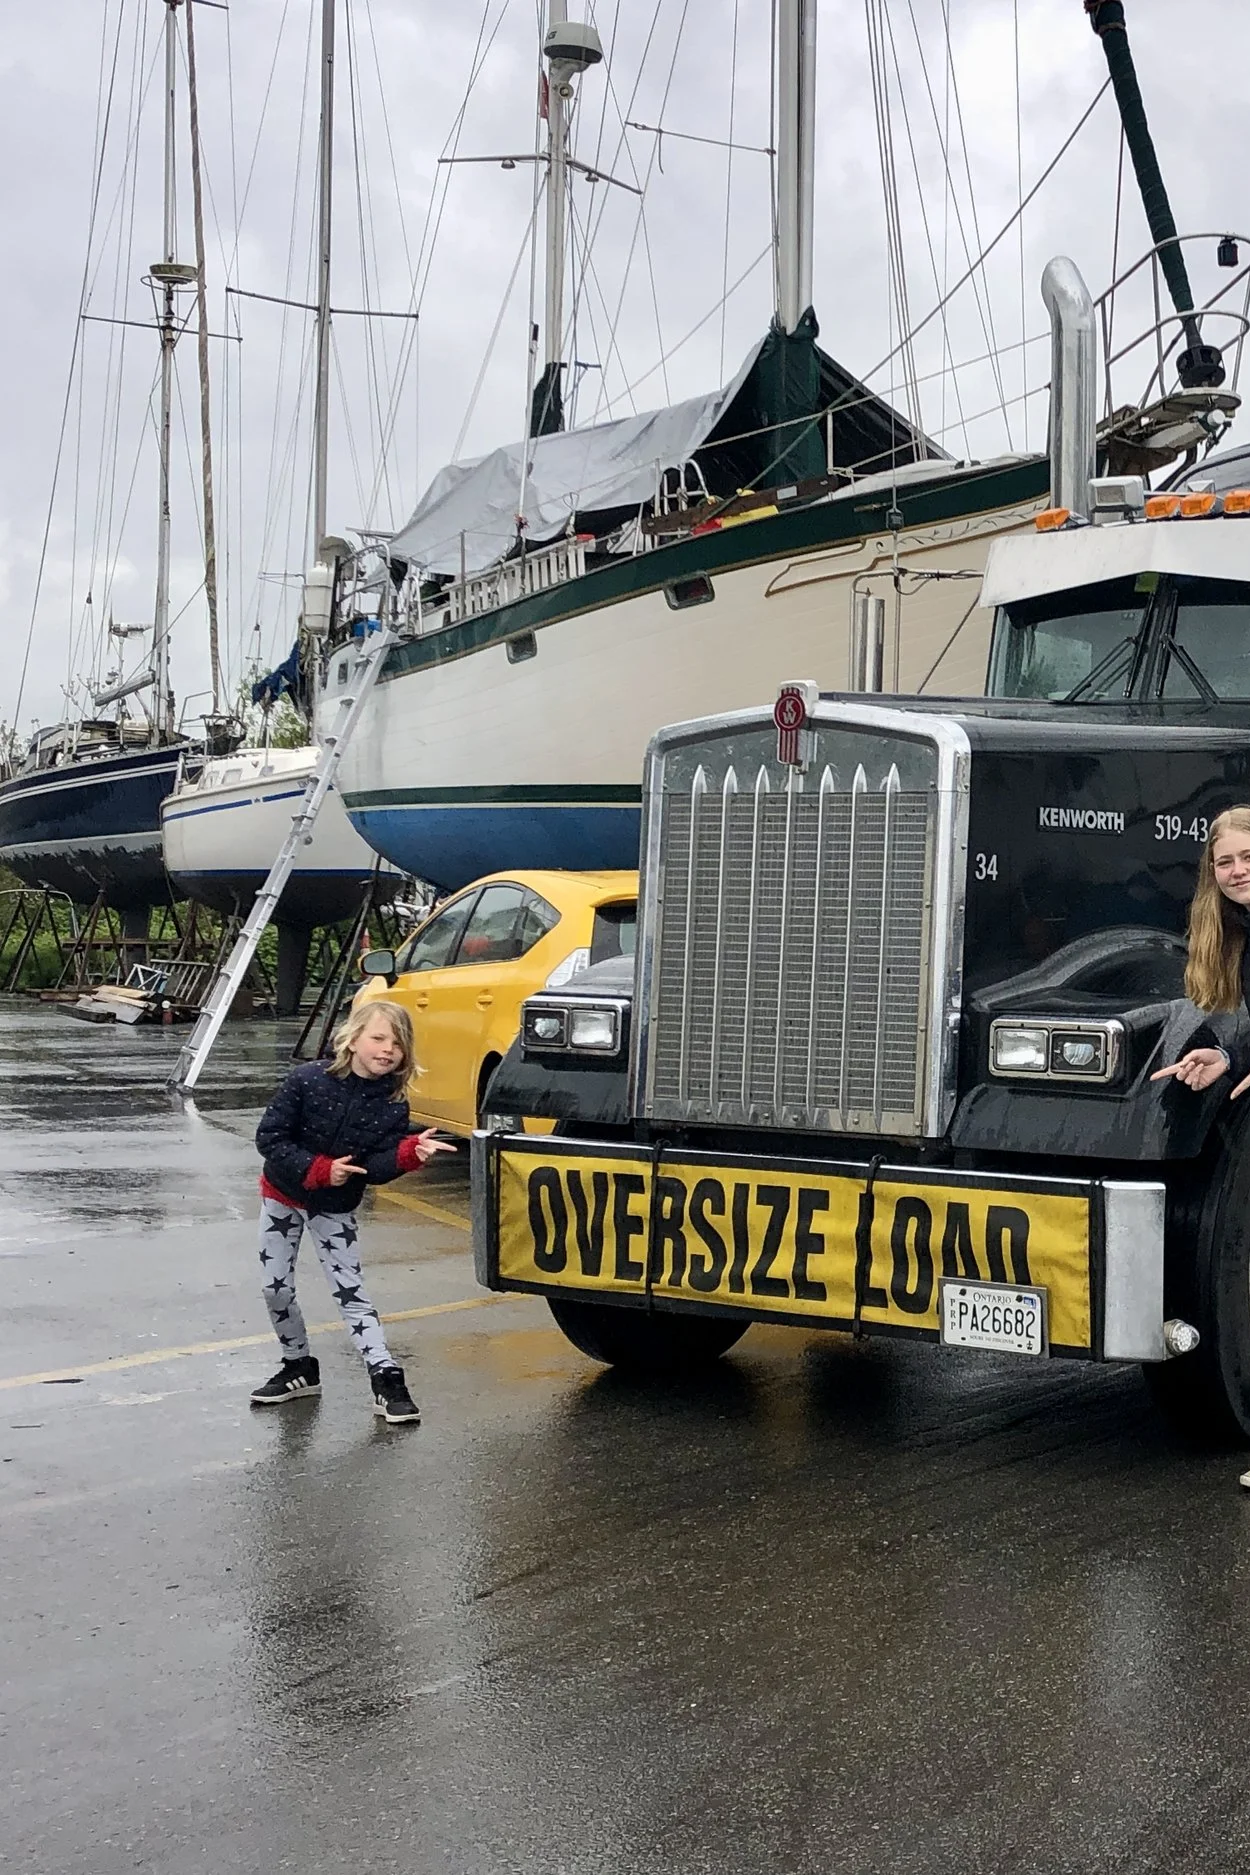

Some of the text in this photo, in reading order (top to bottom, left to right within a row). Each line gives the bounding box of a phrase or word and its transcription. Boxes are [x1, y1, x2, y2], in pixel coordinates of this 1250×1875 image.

[1039, 806, 1125, 831] KENWORTH
[975, 853, 998, 881] 34
[527, 1165, 1032, 1314] OVERSIZE LOAD
[973, 1292, 1011, 1305] ONTARIO
[959, 1301, 1035, 1339] PA26682
